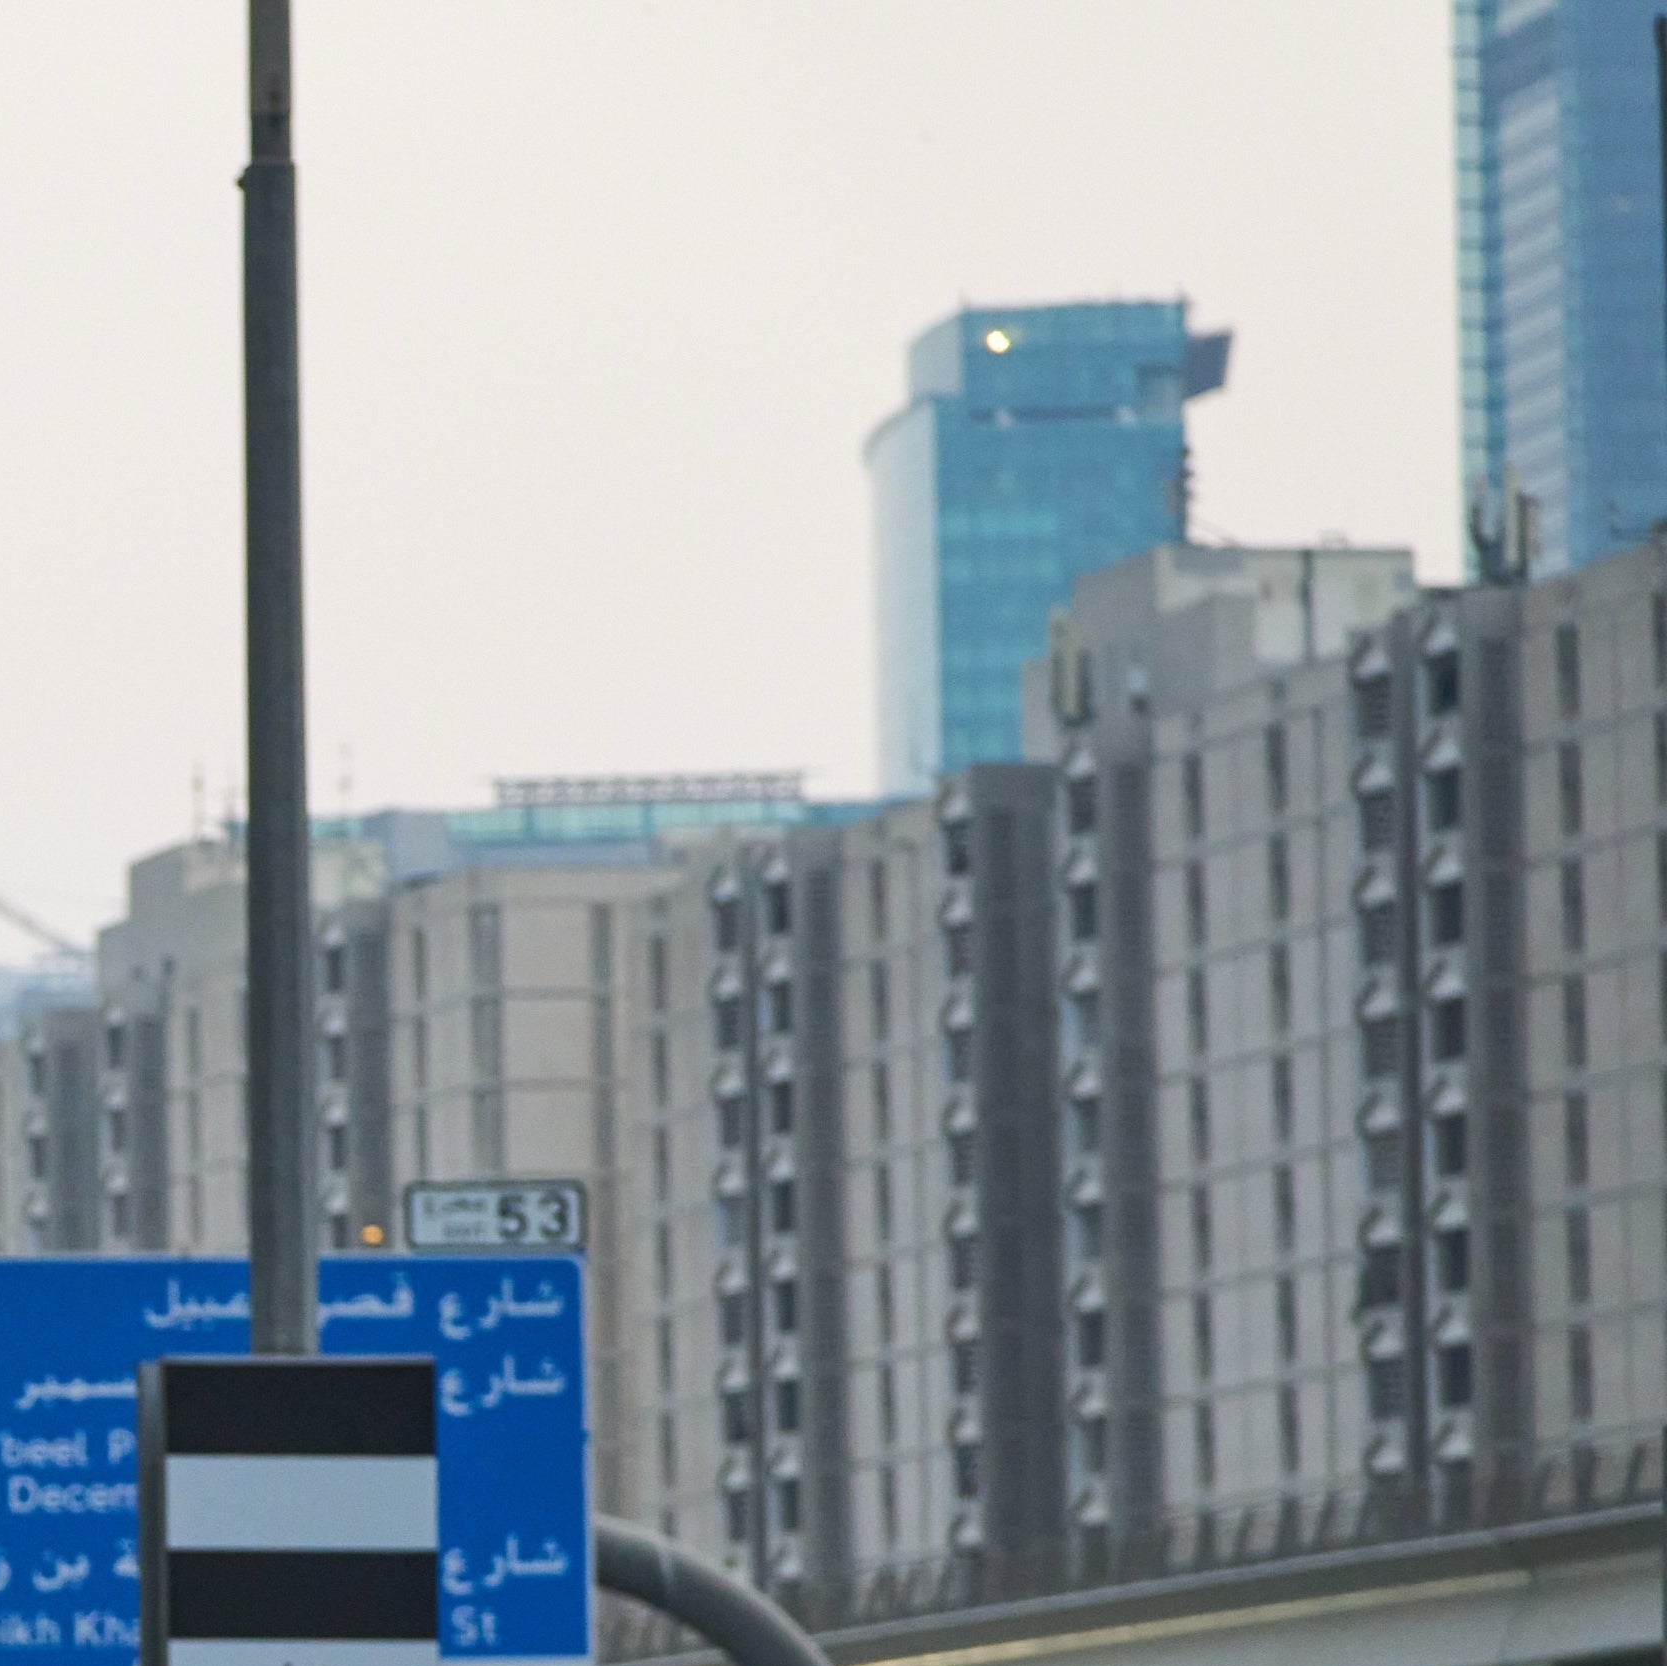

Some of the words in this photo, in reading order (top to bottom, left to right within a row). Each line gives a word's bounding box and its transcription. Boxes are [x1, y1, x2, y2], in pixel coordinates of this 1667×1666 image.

[498, 1192, 566, 1239] 53
[144, 1279, 251, 1330] عبيل
[439, 1272, 562, 1340] شارع
[441, 1354, 564, 1417] شارع
[8, 1475, 138, 1514] Decem
[32, 1549, 90, 1593] بن
[444, 1533, 567, 1595] شارع
[451, 1605, 499, 1648] St
